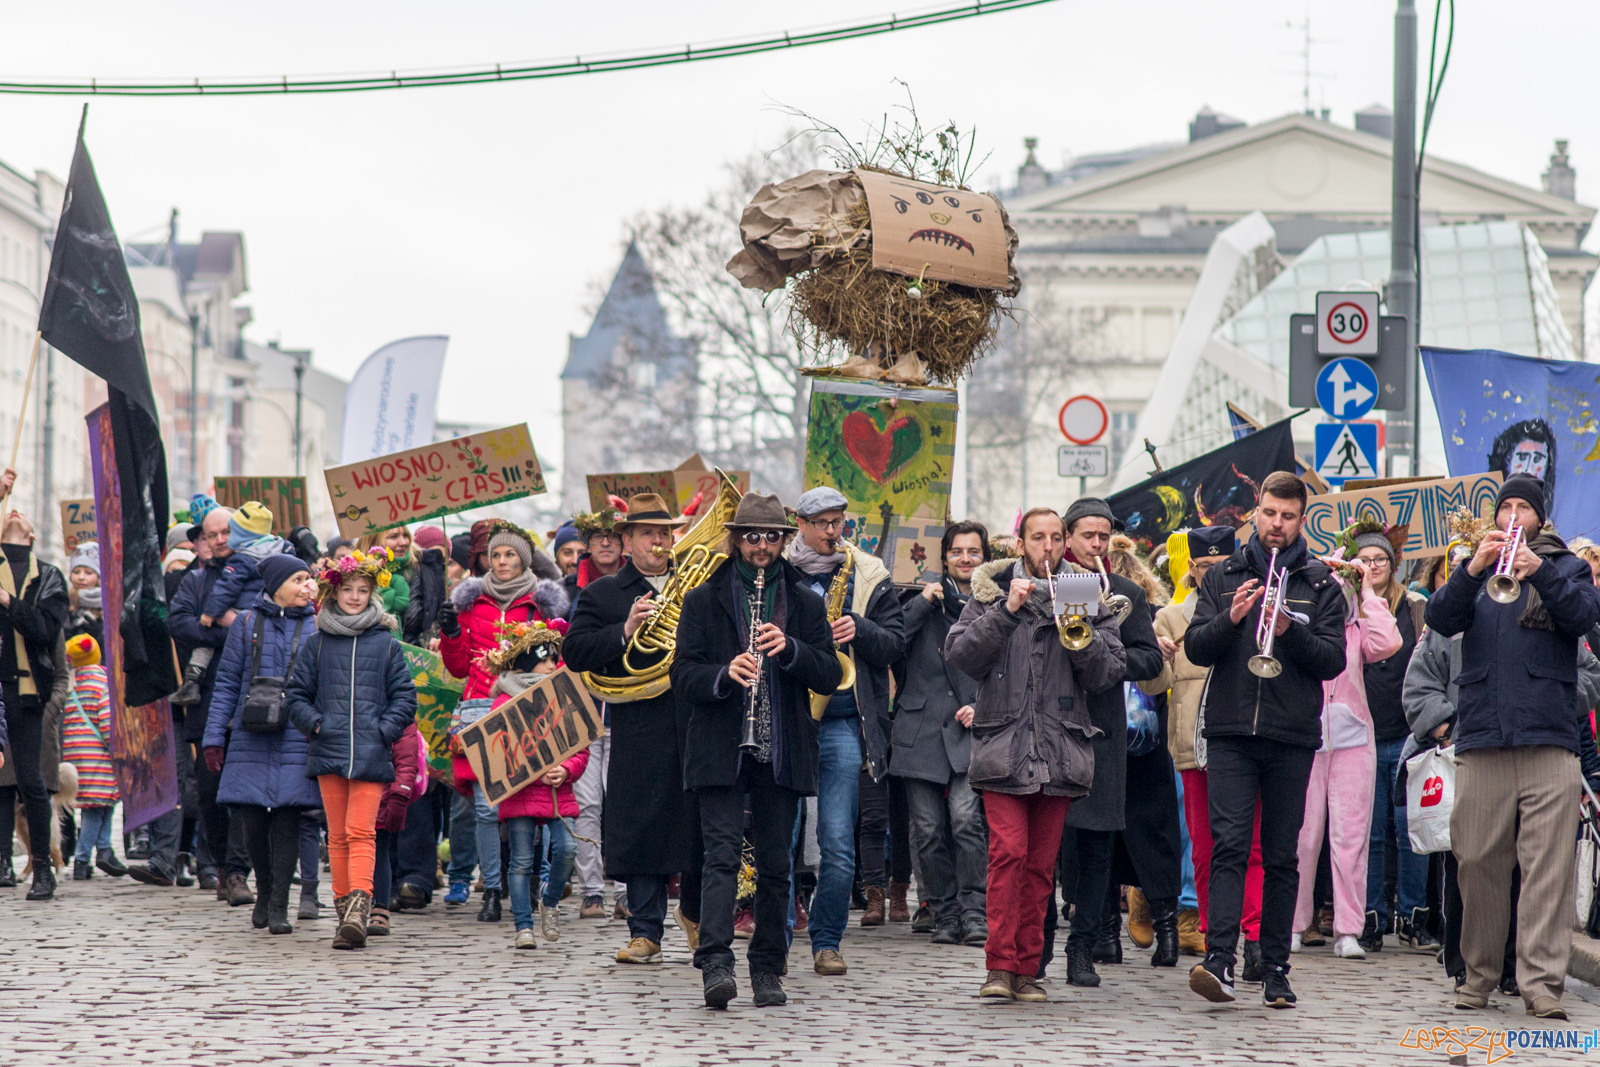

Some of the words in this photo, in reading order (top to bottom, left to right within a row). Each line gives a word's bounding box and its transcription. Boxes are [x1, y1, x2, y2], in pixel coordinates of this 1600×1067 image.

[1333, 313, 1363, 333] 30
[377, 483, 428, 522] JUŻ
[445, 464, 527, 502] CZAS!!!
[892, 459, 948, 494] Wiosna!
[491, 697, 566, 778] Precz
